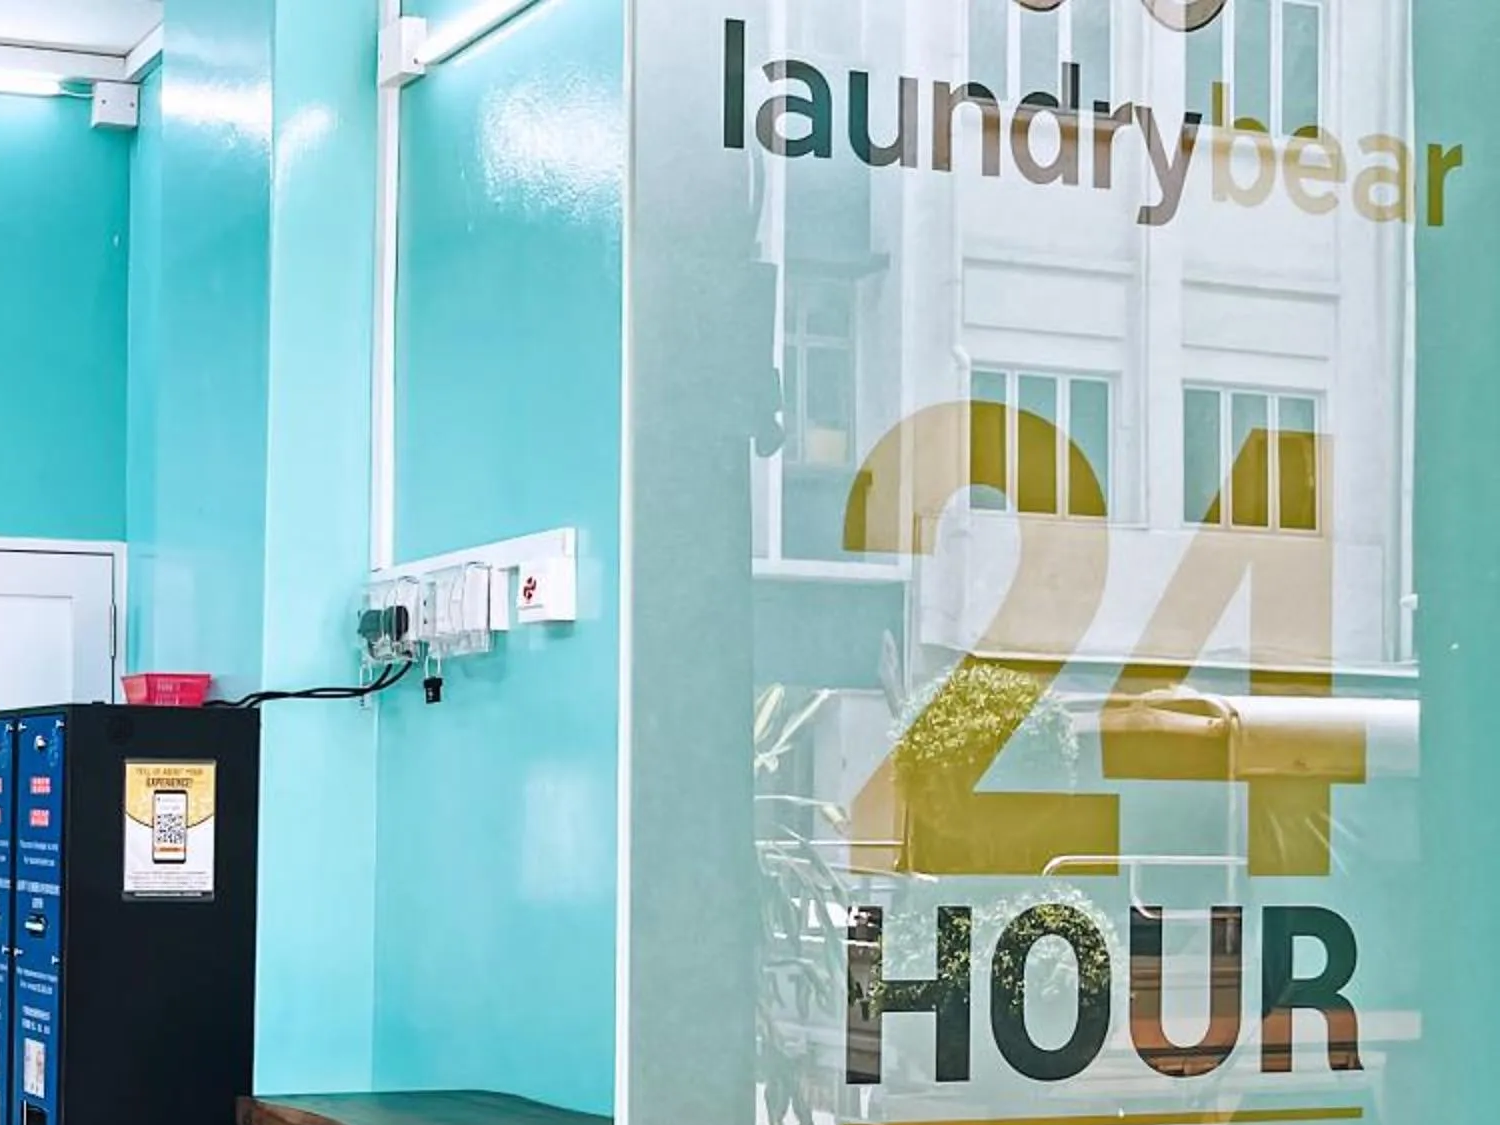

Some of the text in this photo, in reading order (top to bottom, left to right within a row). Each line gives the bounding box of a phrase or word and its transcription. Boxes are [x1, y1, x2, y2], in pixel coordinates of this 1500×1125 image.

[722, 19, 1463, 227] laundrybear
[841, 398, 1367, 877] 24
[844, 903, 1364, 1085] HOUR
